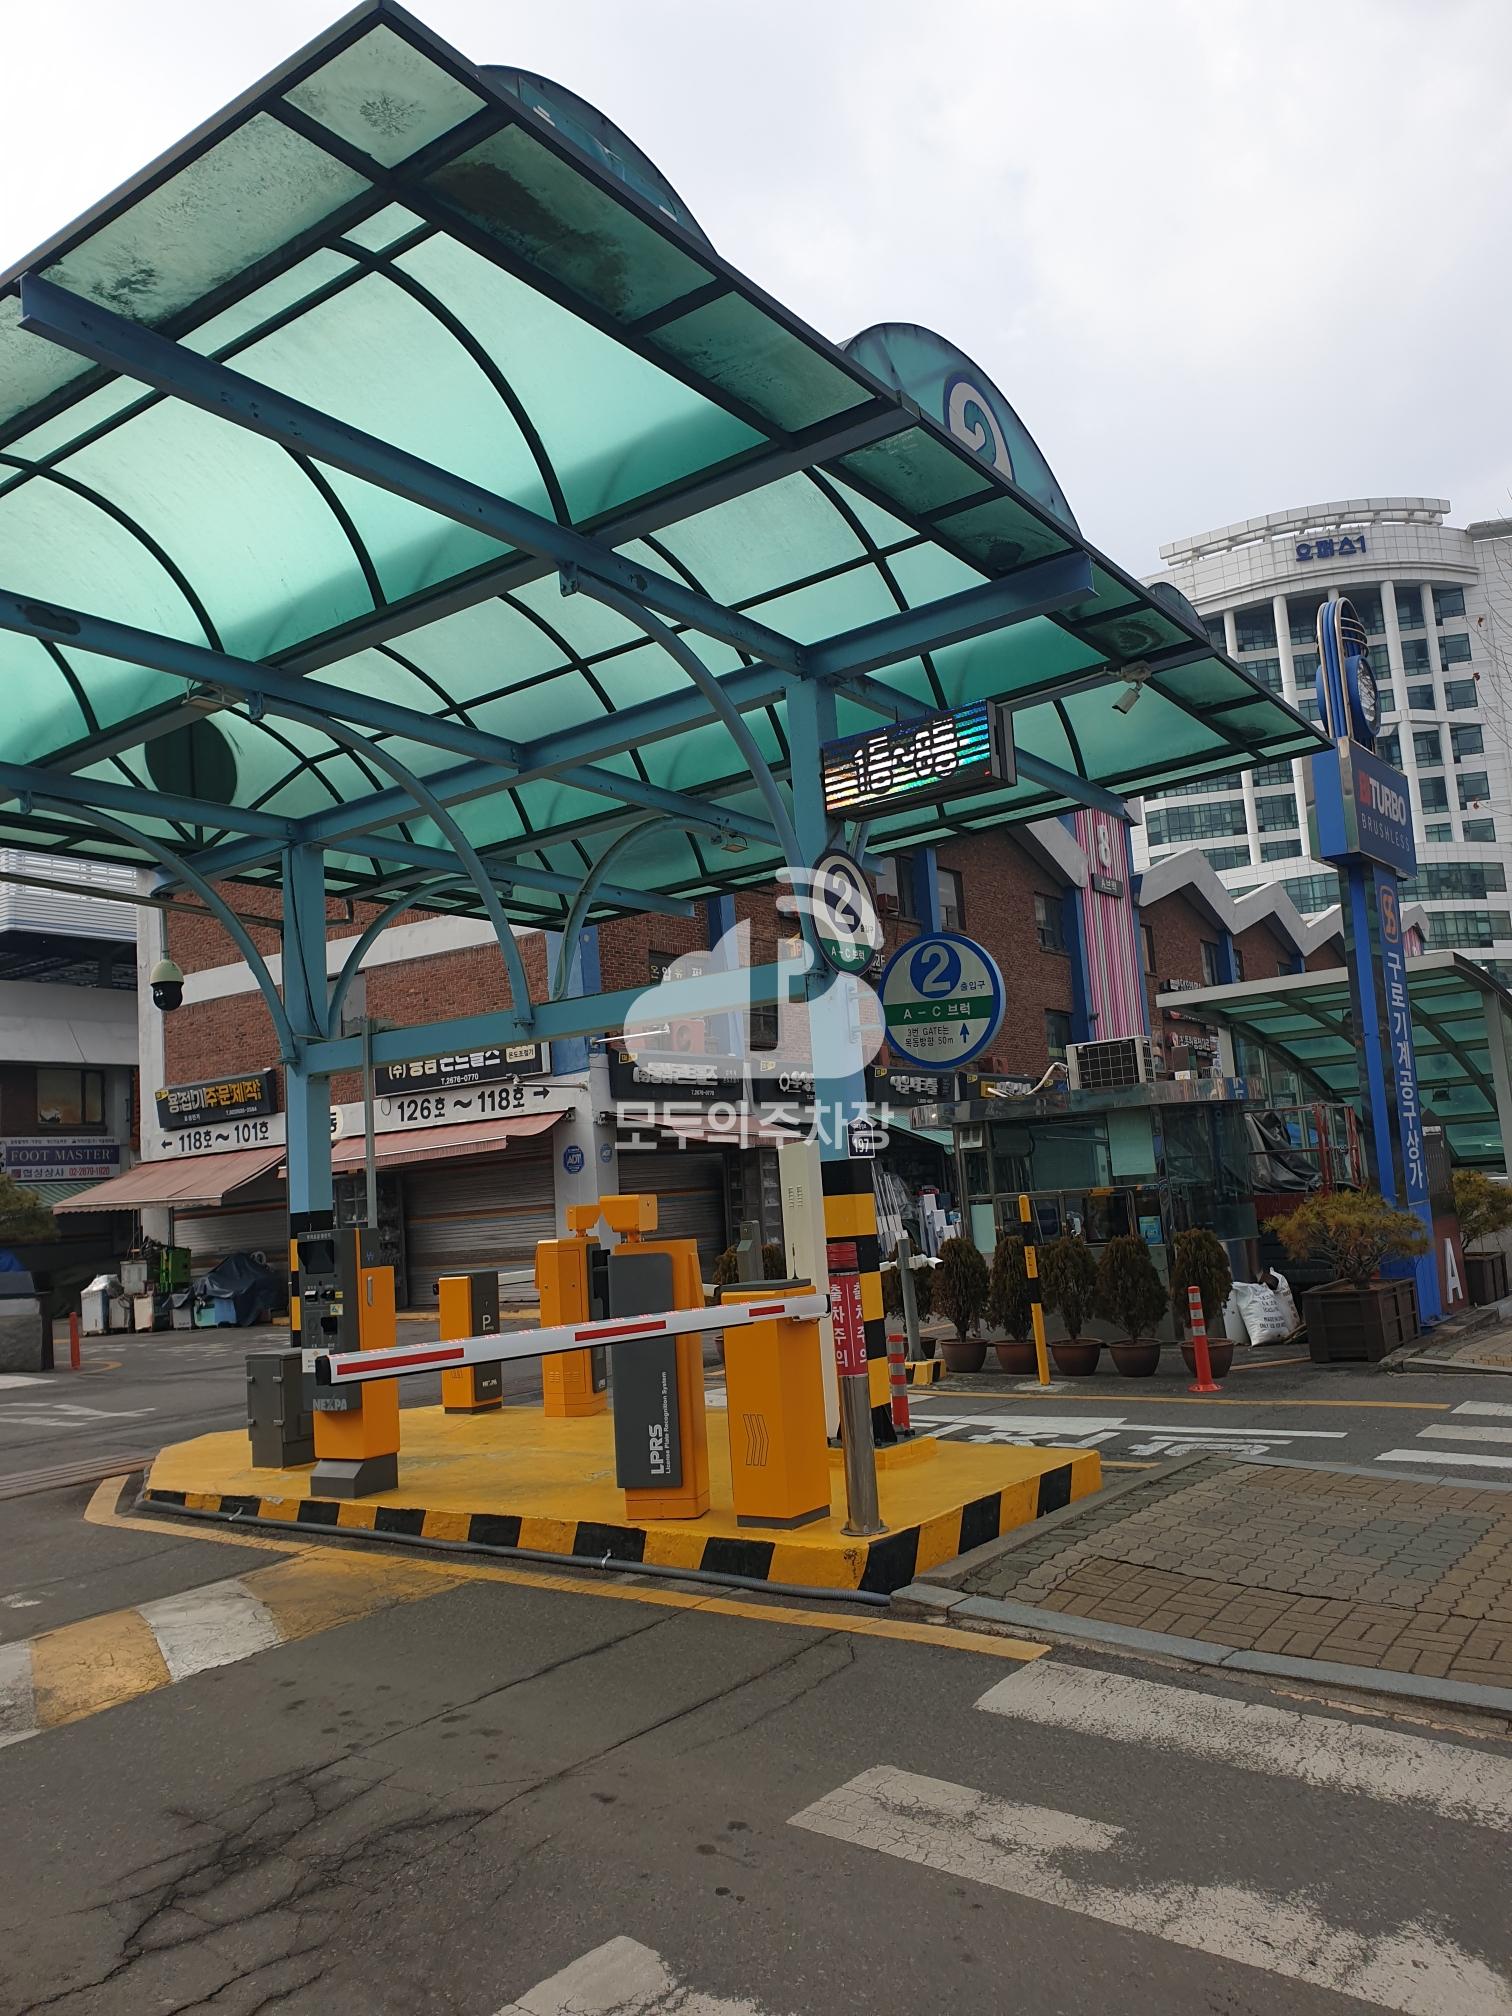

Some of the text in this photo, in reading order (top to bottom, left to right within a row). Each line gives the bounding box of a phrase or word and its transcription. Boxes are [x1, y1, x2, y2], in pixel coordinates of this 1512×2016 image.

[1097, 824, 1112, 868] 8
[1361, 812, 1410, 852] BRUSHLESS
[832, 870, 855, 925] 2
[920, 944, 951, 993] 2
[960, 980, 986, 991] 출입구
[903, 1008, 913, 1019] A
[932, 1005, 941, 1017] C
[907, 1027, 919, 1037] 3번
[1386, 951, 1424, 1190] 구로기계공구상가
[397, 1096, 446, 1122] 126호
[477, 1087, 525, 1113] 118호
[179, 1129, 213, 1152] 118호
[234, 1120, 269, 1144] 101호
[854, 1138, 870, 1153] 197
[11, 1149, 110, 1161] FOOT MASTER
[1444, 1237, 1464, 1304] A
[830, 1284, 848, 1363] 출차주의
[312, 1398, 348, 1411] NEXPA
[648, 1423, 665, 1475] LPRS
